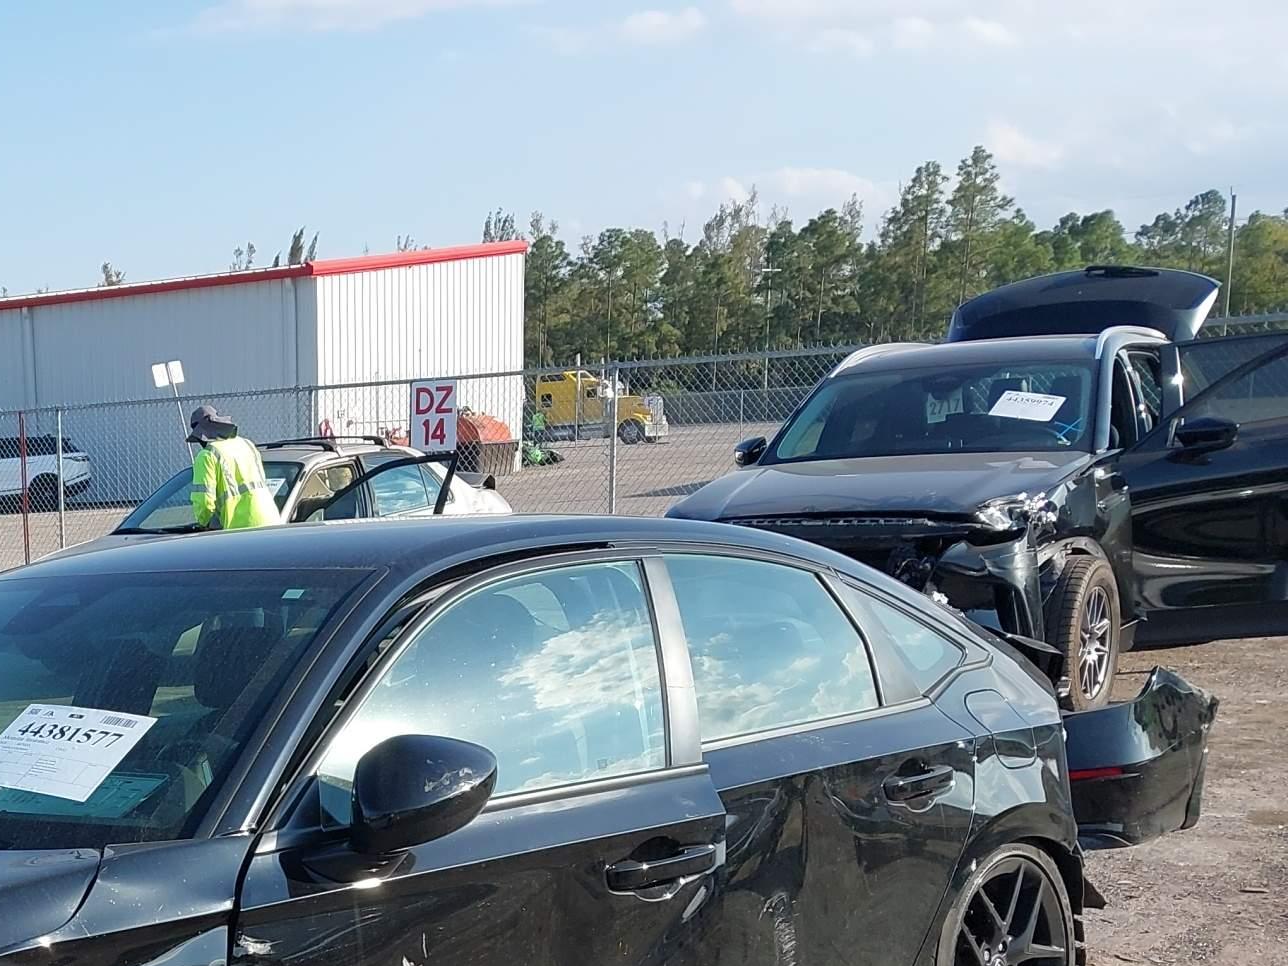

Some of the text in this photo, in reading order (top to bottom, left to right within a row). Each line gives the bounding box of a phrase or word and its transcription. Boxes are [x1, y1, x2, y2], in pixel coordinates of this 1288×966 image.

[416, 385, 453, 415] DZ
[422, 418, 446, 446] 14
[17, 721, 124, 748] 44381577
